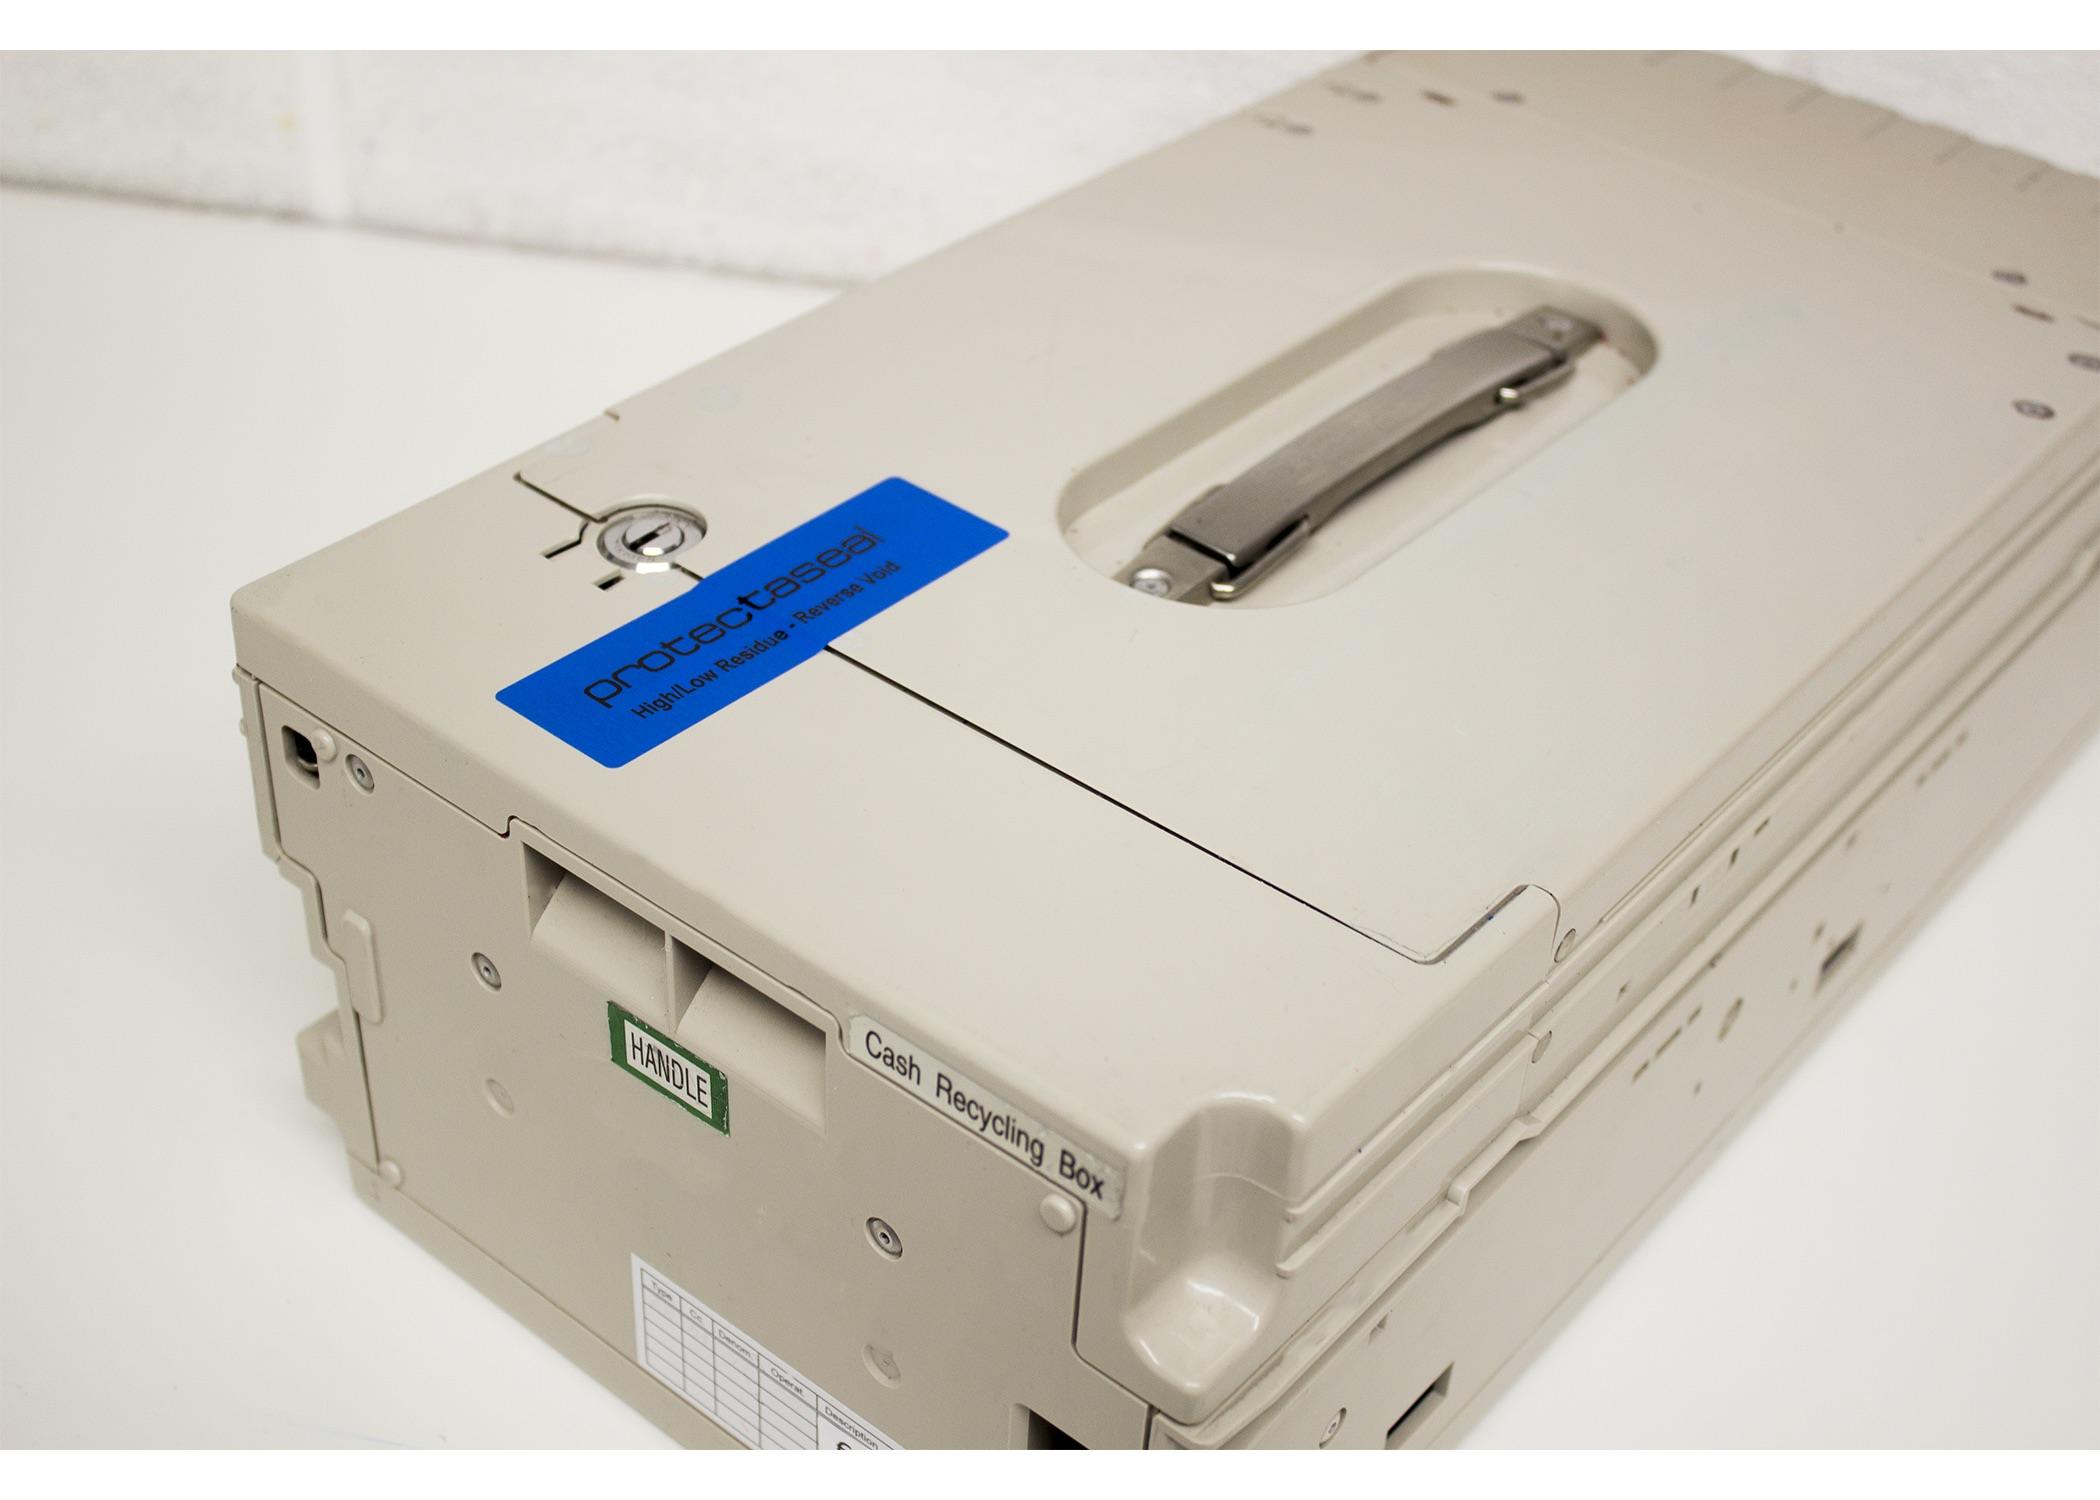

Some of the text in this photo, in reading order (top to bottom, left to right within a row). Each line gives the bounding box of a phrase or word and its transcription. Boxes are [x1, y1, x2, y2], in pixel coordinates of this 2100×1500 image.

[584, 524, 884, 709] protectaseal
[630, 669, 719, 719] High/Low
[714, 629, 789, 674] Residue
[793, 583, 864, 623] Reverse
[860, 560, 901, 585] Void
[631, 1031, 709, 1109] HANDLE
[865, 1030, 1105, 1200] Cash Recycling Box
[825, 1406, 879, 1450] Description
